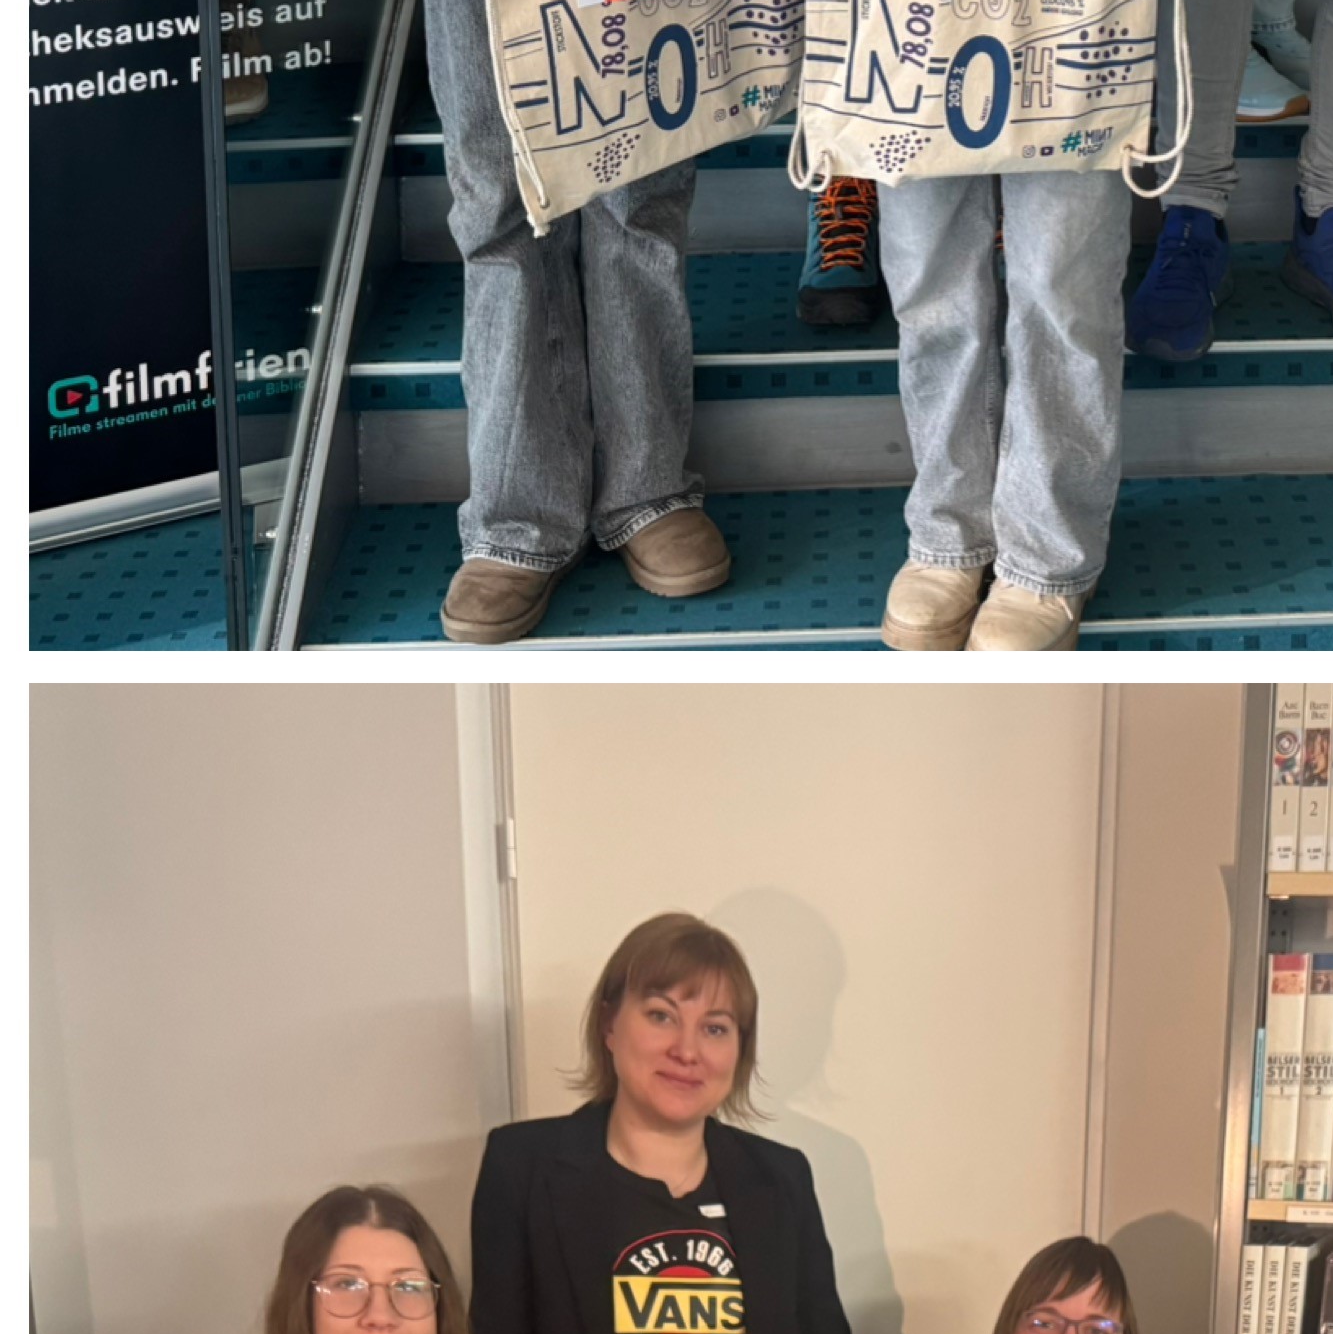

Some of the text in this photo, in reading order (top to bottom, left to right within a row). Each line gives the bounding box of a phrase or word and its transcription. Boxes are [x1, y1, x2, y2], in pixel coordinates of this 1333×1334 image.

[899, 2, 935, 69] 78,08
[284, 39, 332, 70] ab!
[49, 398, 197, 440] Filme streamen mit
[1282, 800, 1288, 815] 1
[1309, 801, 1318, 816] 2
[1267, 1067, 1300, 1079] STIL
[1279, 1087, 1285, 1095] 1
[1315, 1087, 1322, 1096] 2
[628, 1239, 734, 1276] EST. 1966
[1246, 1260, 1256, 1279] DIE
[1268, 1260, 1279, 1278] DIE
[1291, 1261, 1301, 1279] DIE
[617, 1281, 745, 1330] VANS
[1242, 1312, 1251, 1334] DER
[1265, 1314, 1275, 1334] DER
[1286, 1315, 1297, 1334] DER
